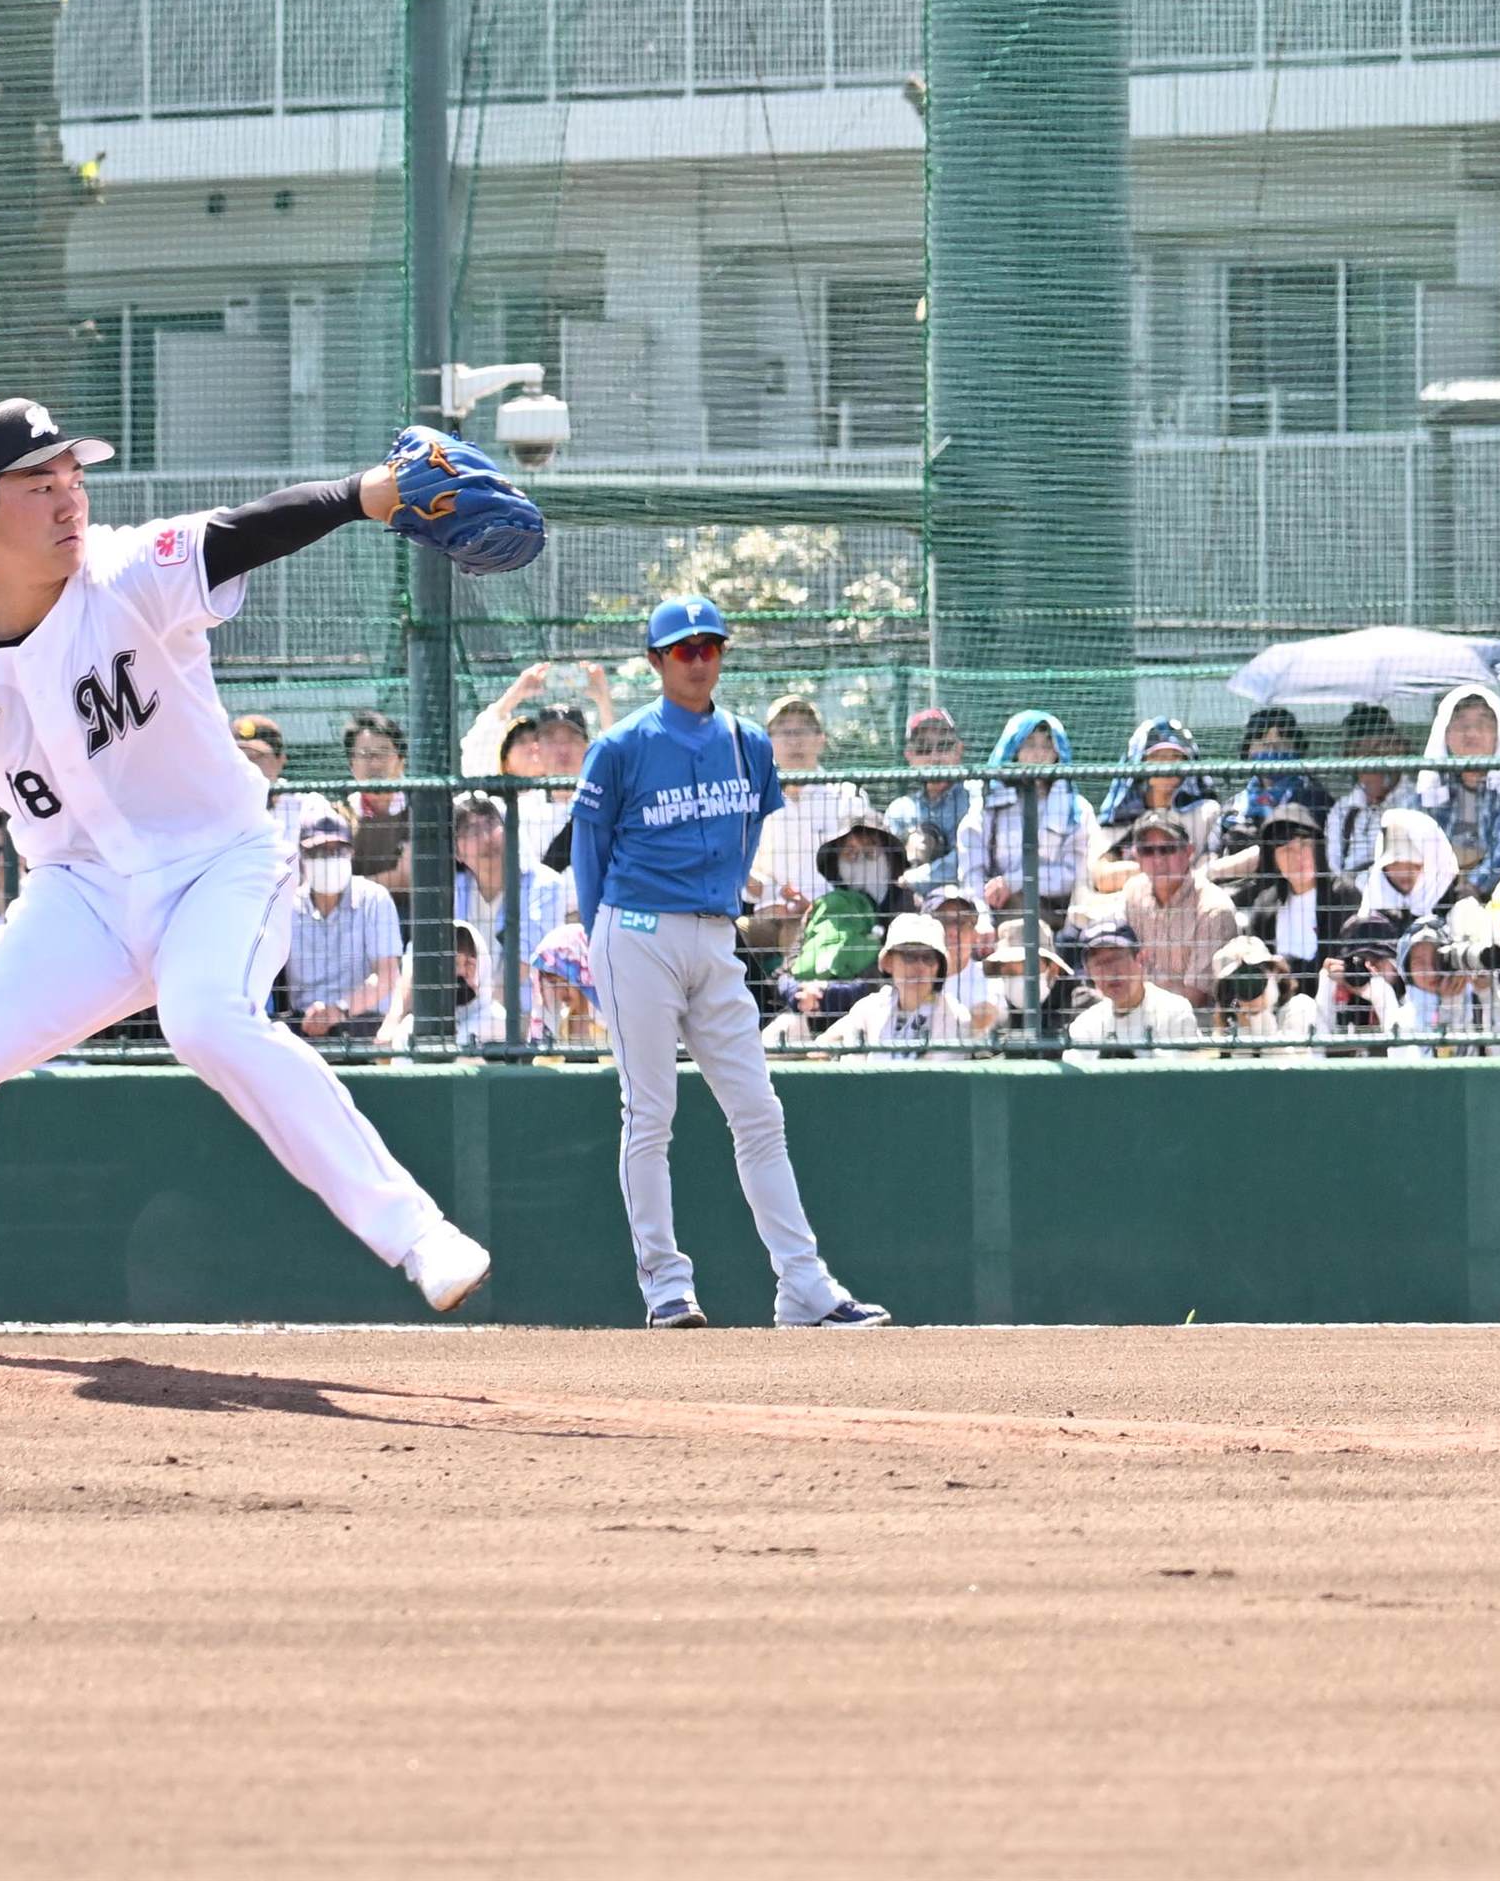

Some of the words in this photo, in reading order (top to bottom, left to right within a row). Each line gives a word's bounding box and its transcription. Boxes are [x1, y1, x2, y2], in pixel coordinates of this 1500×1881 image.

[73, 649, 161, 760] M
[656, 778, 751, 805] HOKKAIDO
[642, 793, 761, 826] NIPPONHAM
